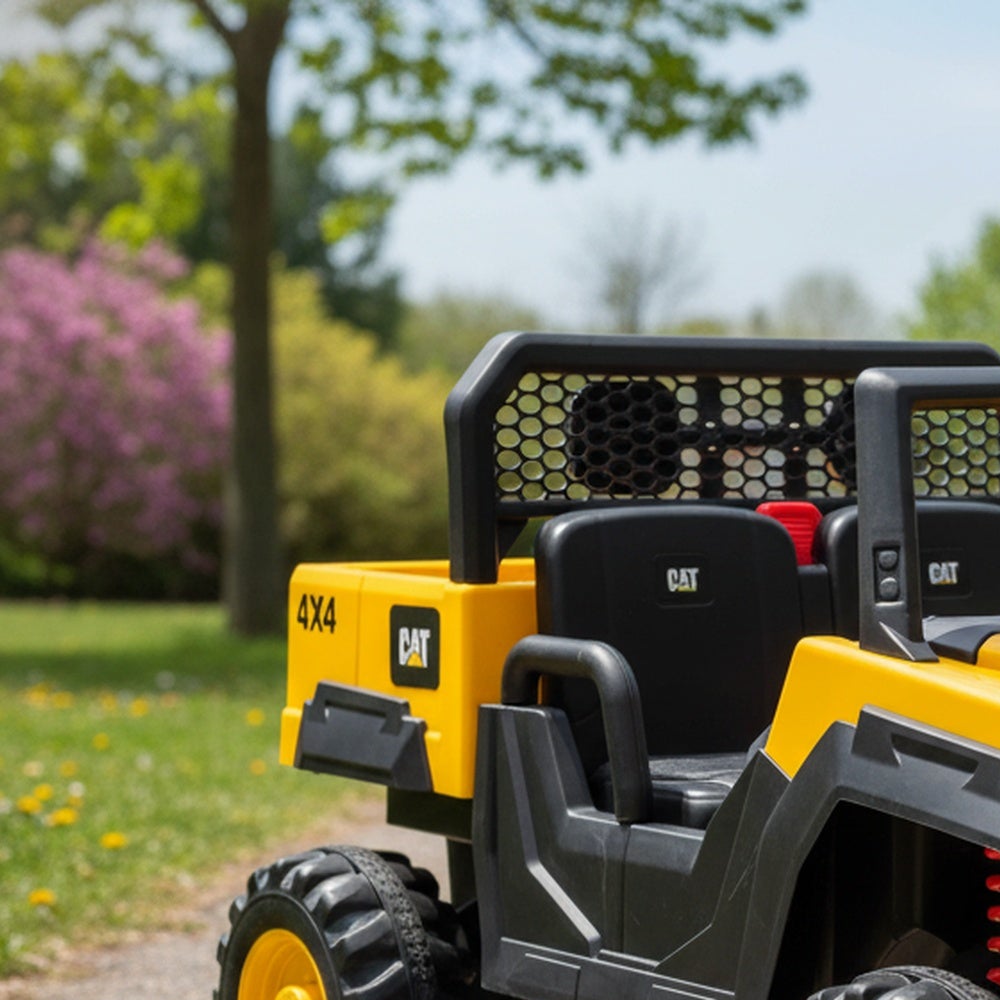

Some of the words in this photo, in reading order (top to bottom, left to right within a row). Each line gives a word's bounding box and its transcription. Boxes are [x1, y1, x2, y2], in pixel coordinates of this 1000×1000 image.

[666, 567, 699, 592] CAT
[928, 562, 959, 585] CAT
[297, 593, 336, 634] 4X4
[399, 627, 431, 668] CAT
